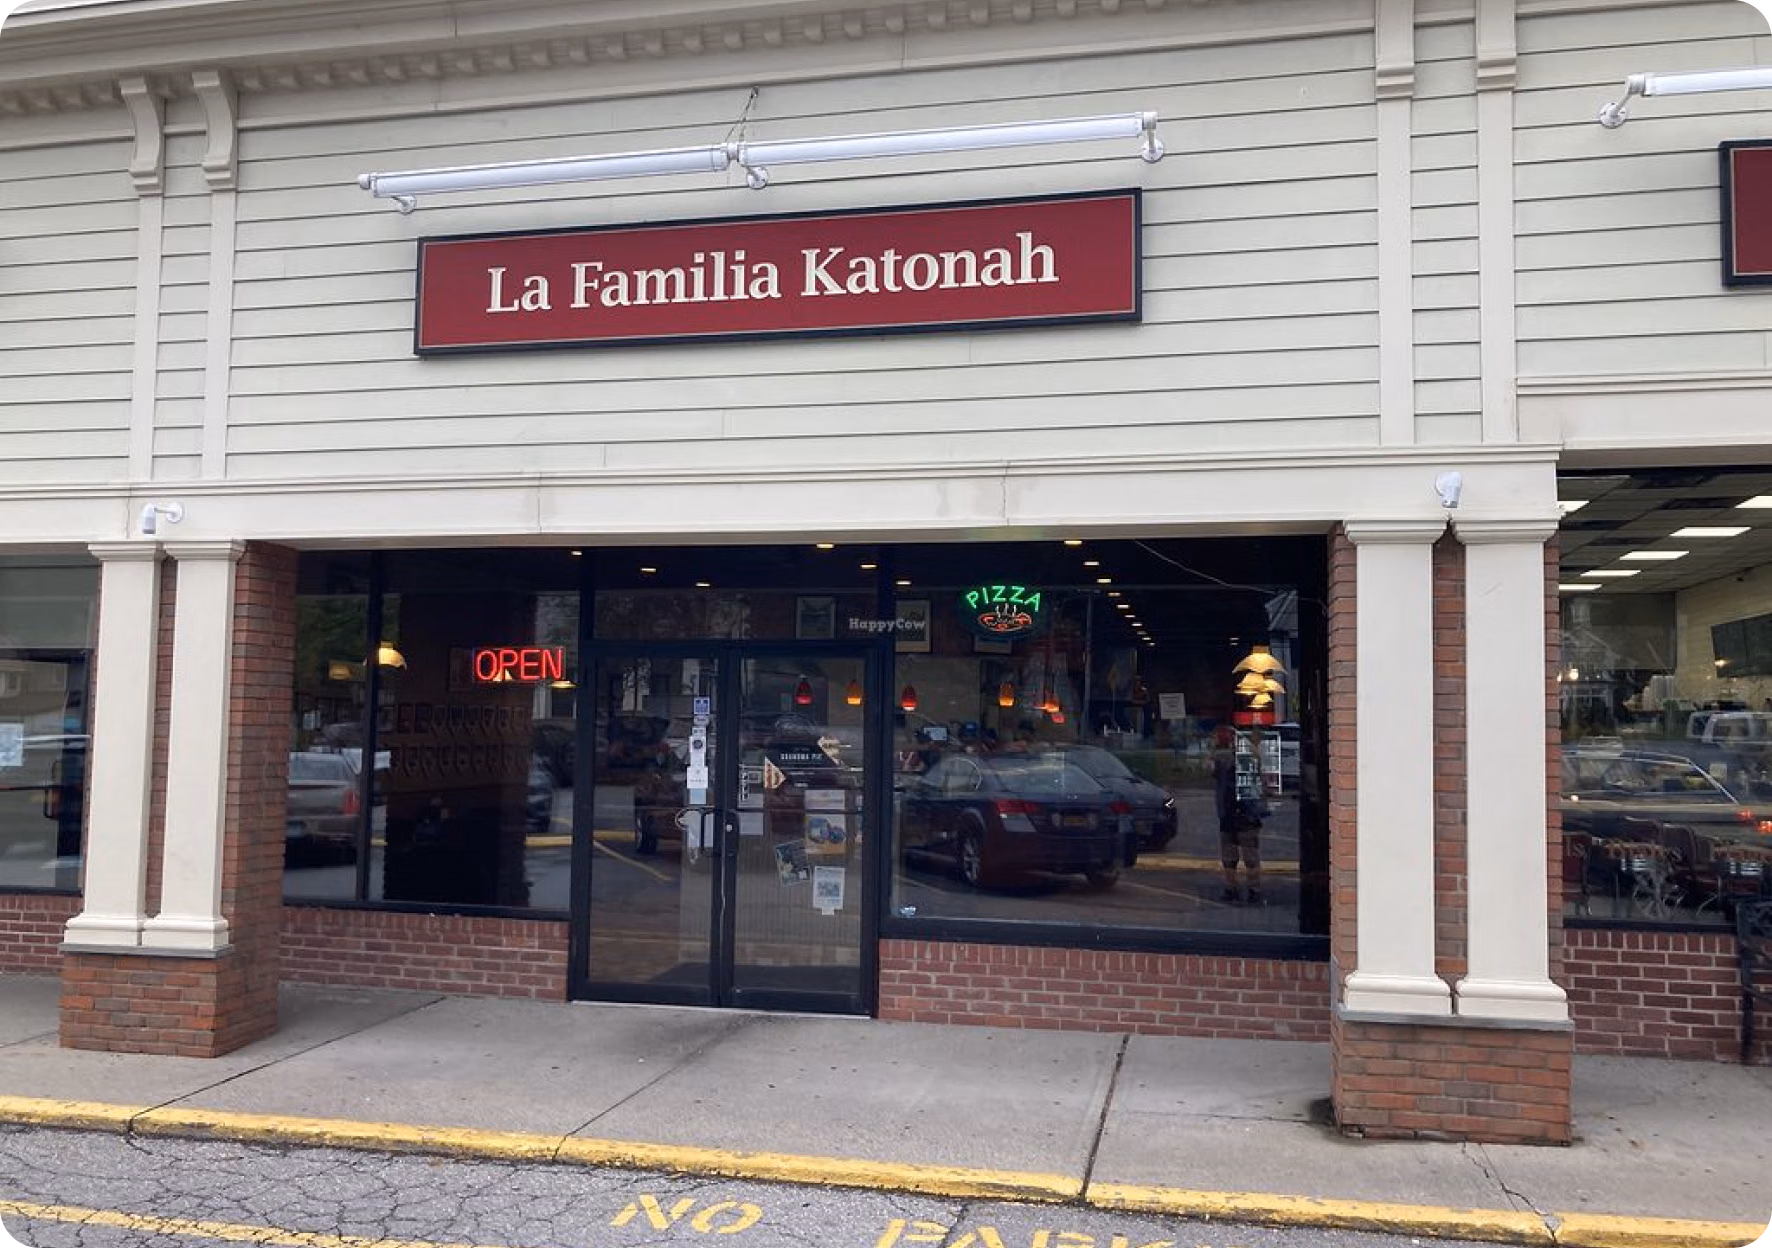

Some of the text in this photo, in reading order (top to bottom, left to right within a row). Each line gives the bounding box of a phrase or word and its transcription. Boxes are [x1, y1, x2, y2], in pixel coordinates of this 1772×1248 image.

[486, 231, 1060, 313] La Familia Katonah
[965, 584, 1042, 613] PIZZA
[474, 647, 563, 681] OPEN
[609, 1194, 763, 1234] NO
